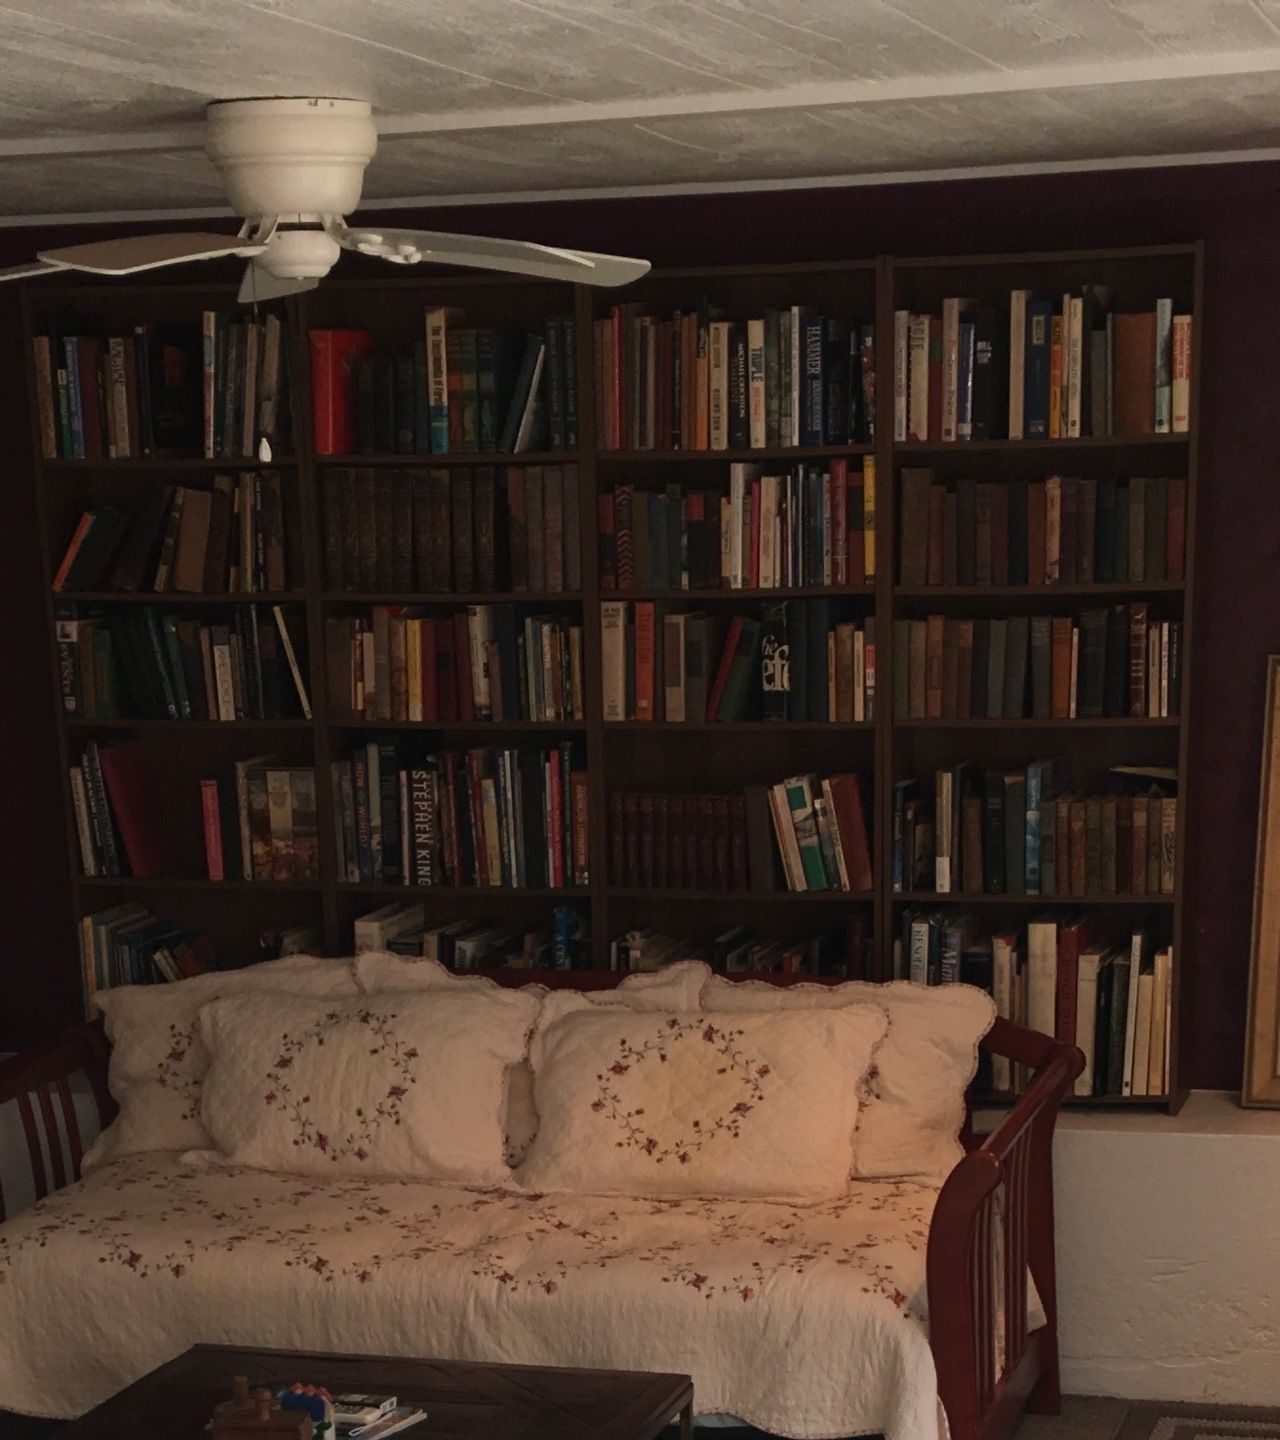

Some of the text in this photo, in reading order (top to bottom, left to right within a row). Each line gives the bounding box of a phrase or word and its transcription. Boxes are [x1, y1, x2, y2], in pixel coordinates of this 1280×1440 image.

[737, 342, 747, 419] MICHAEL CRICHTON
[751, 346, 763, 382] TRIPLE
[806, 326, 821, 375] HAMMER
[412, 770, 432, 886] STEPHEN KING
